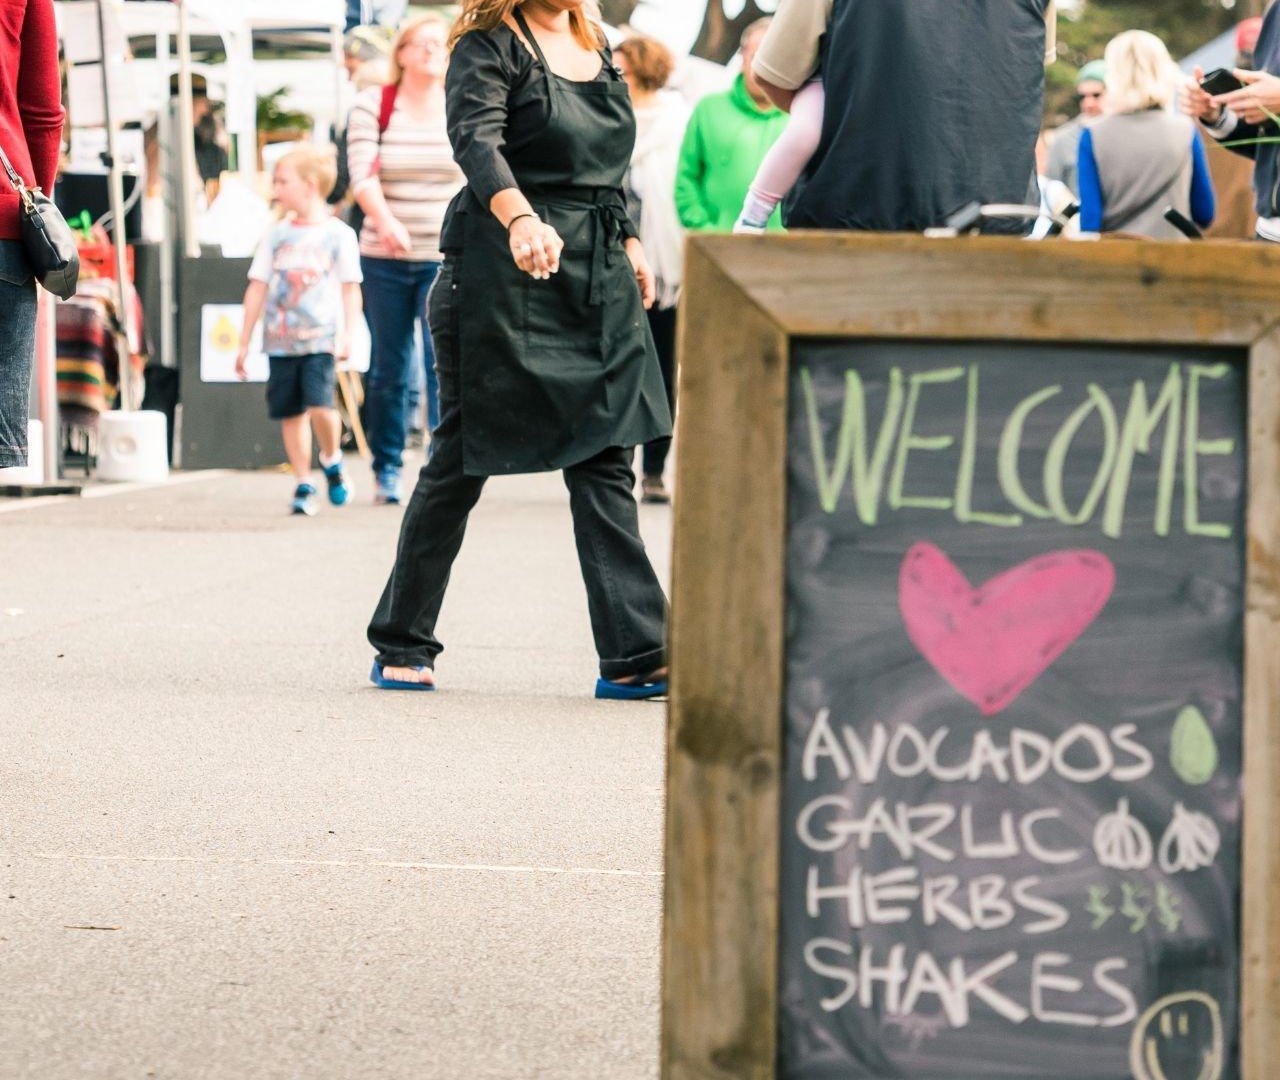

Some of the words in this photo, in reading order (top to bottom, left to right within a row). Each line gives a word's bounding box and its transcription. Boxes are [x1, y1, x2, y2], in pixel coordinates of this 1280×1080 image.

[800, 362, 1235, 538] WELCOME
[802, 707, 1154, 783] AVOCADOS
[797, 794, 1081, 864] GARLIC
[806, 864, 1070, 934] HERBS
[803, 937, 1137, 1028] SHAKES
